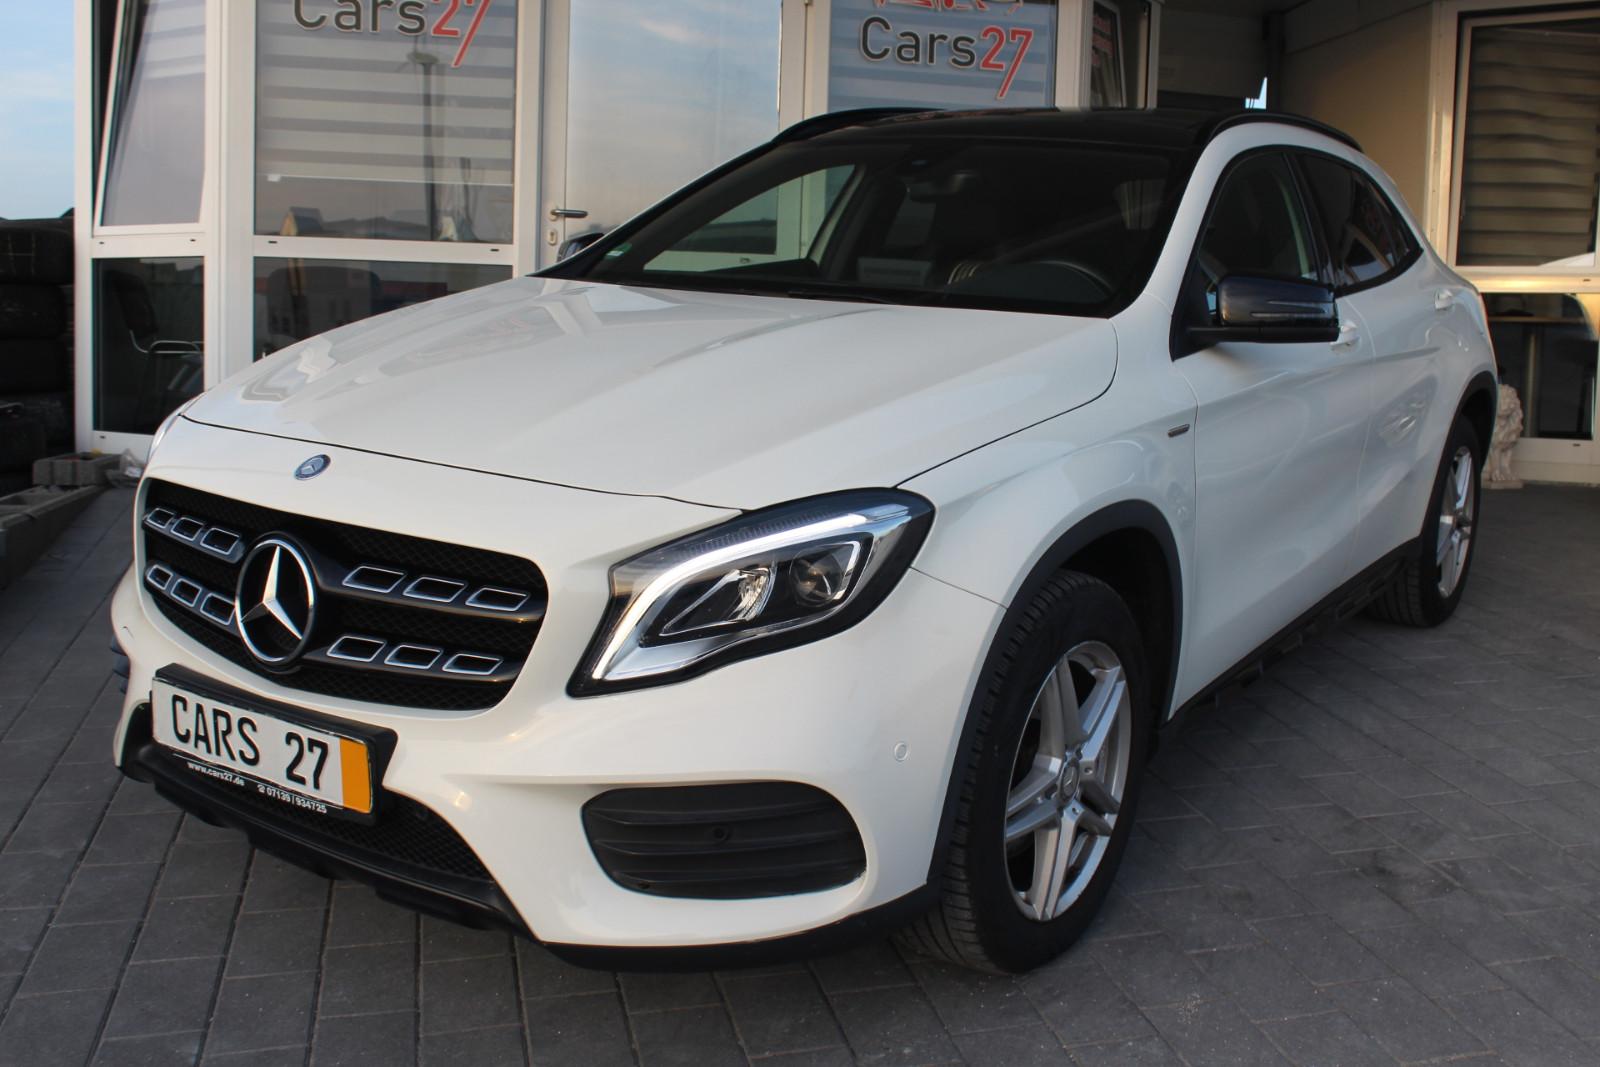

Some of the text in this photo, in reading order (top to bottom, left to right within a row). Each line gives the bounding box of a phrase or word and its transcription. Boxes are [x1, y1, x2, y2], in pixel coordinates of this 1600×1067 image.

[294, 0, 490, 67] Cars27
[861, 16, 1033, 99] Cars27
[171, 693, 329, 790] CARS 27
[187, 761, 245, 787] www.cars27.de
